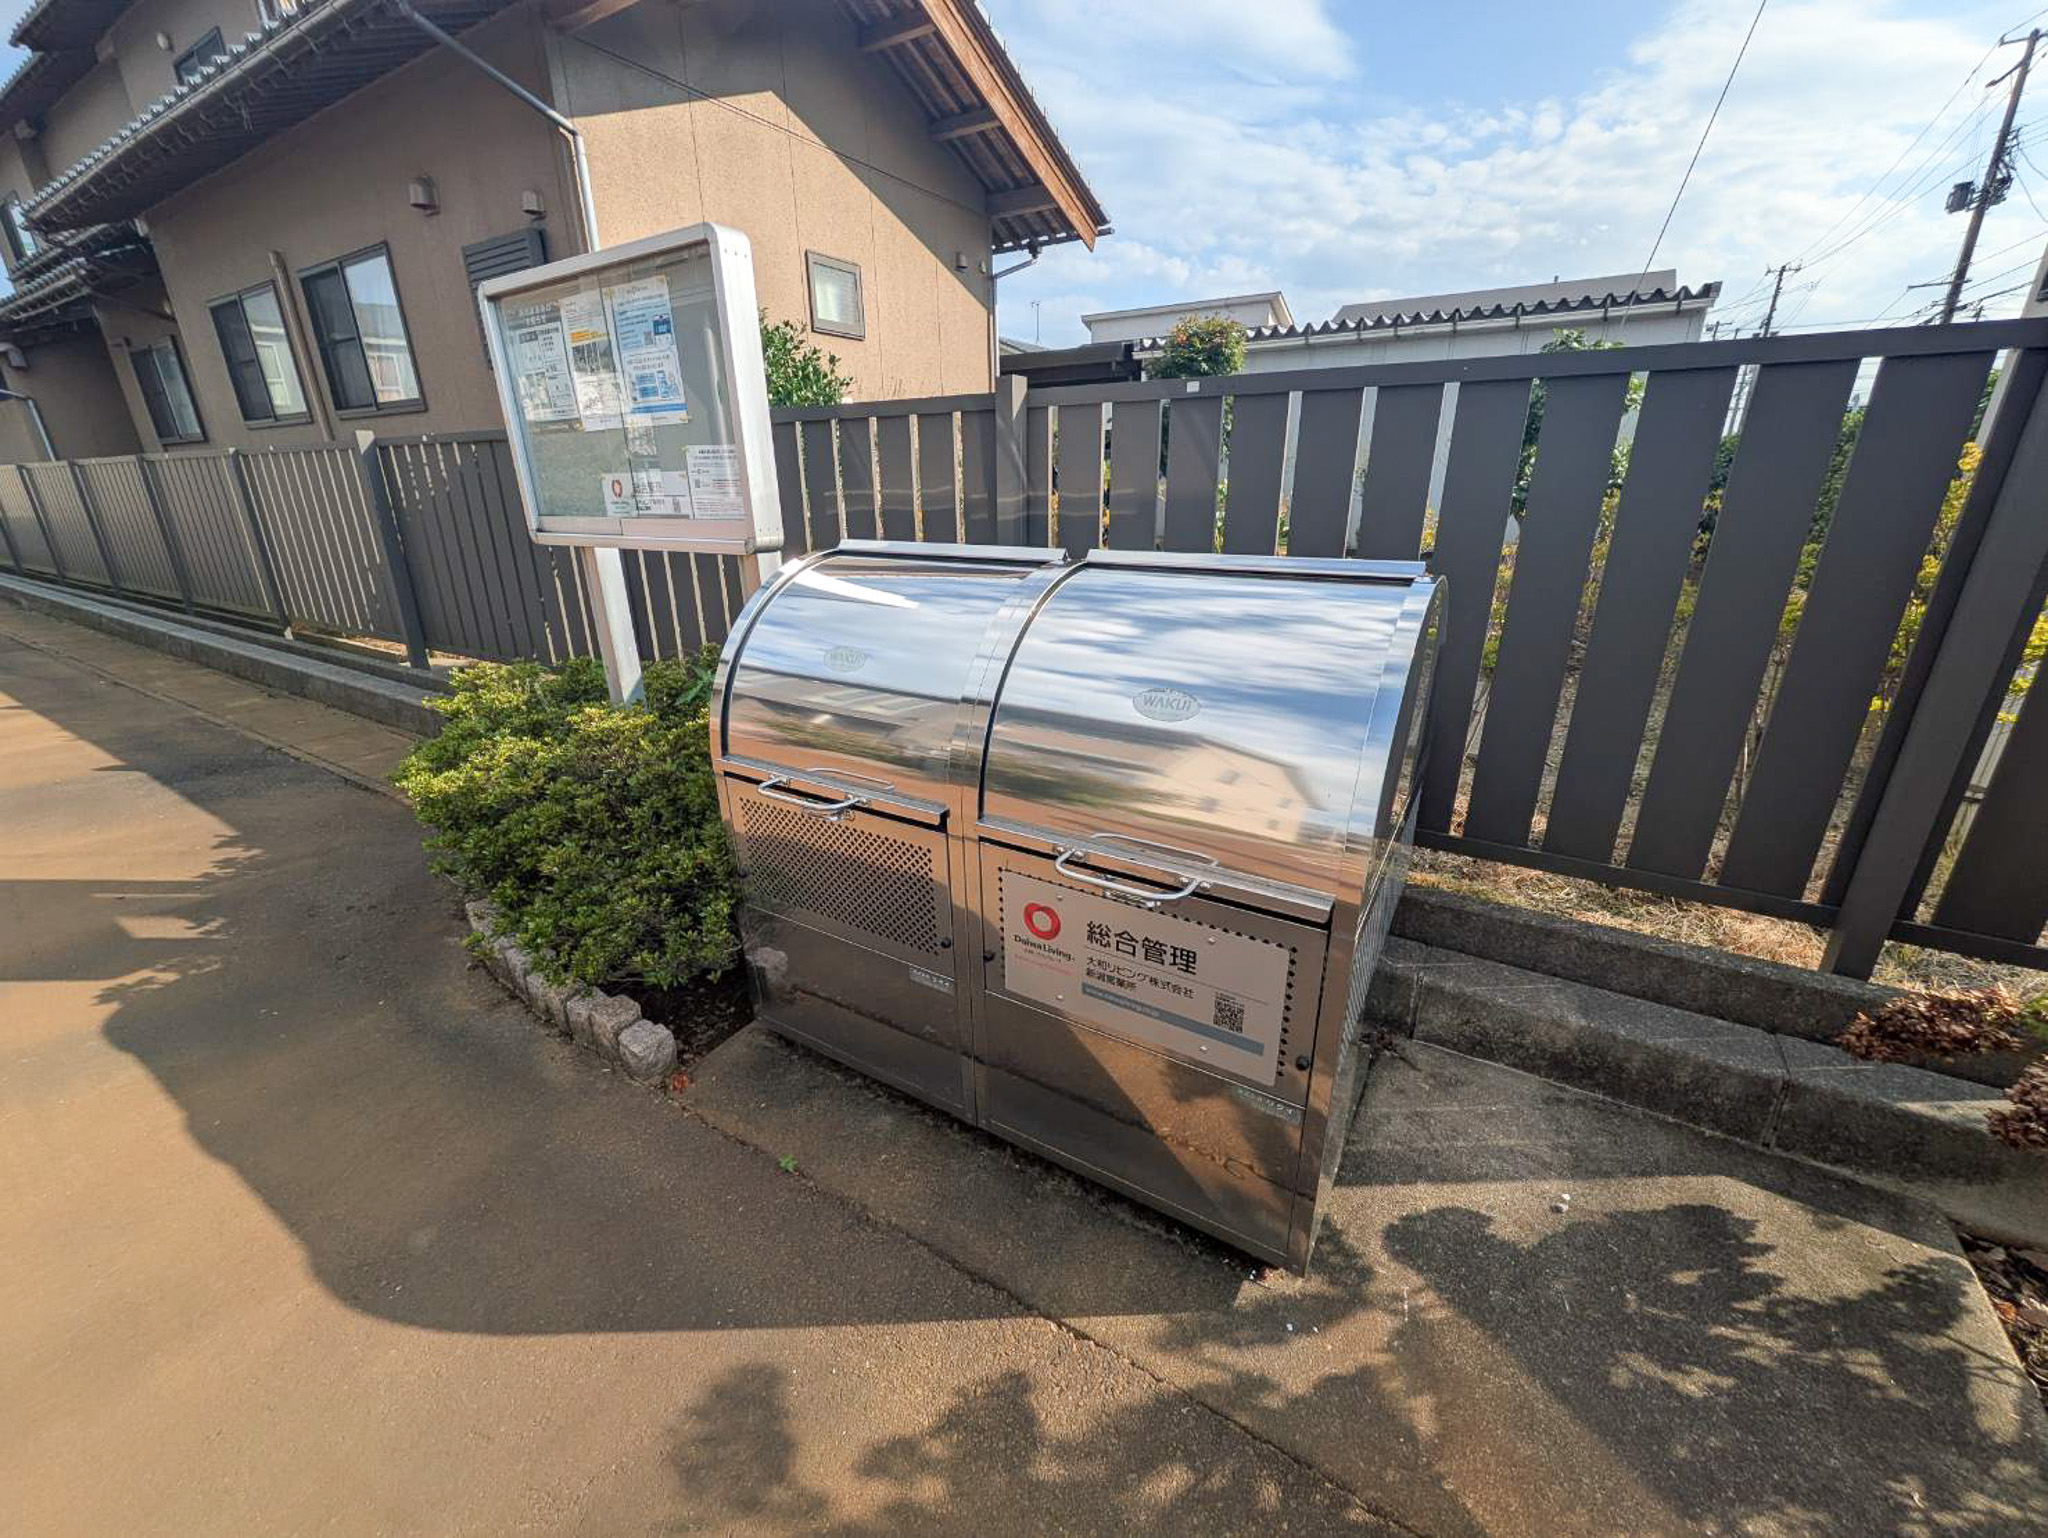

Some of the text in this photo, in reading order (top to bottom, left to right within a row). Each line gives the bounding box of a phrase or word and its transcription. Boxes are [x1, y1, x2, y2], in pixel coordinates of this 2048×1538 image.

[1143, 694, 1191, 712] WAKUI
[1086, 920, 1197, 976] 総合管理
[1086, 956, 1195, 999] 大和リビング株式会社
